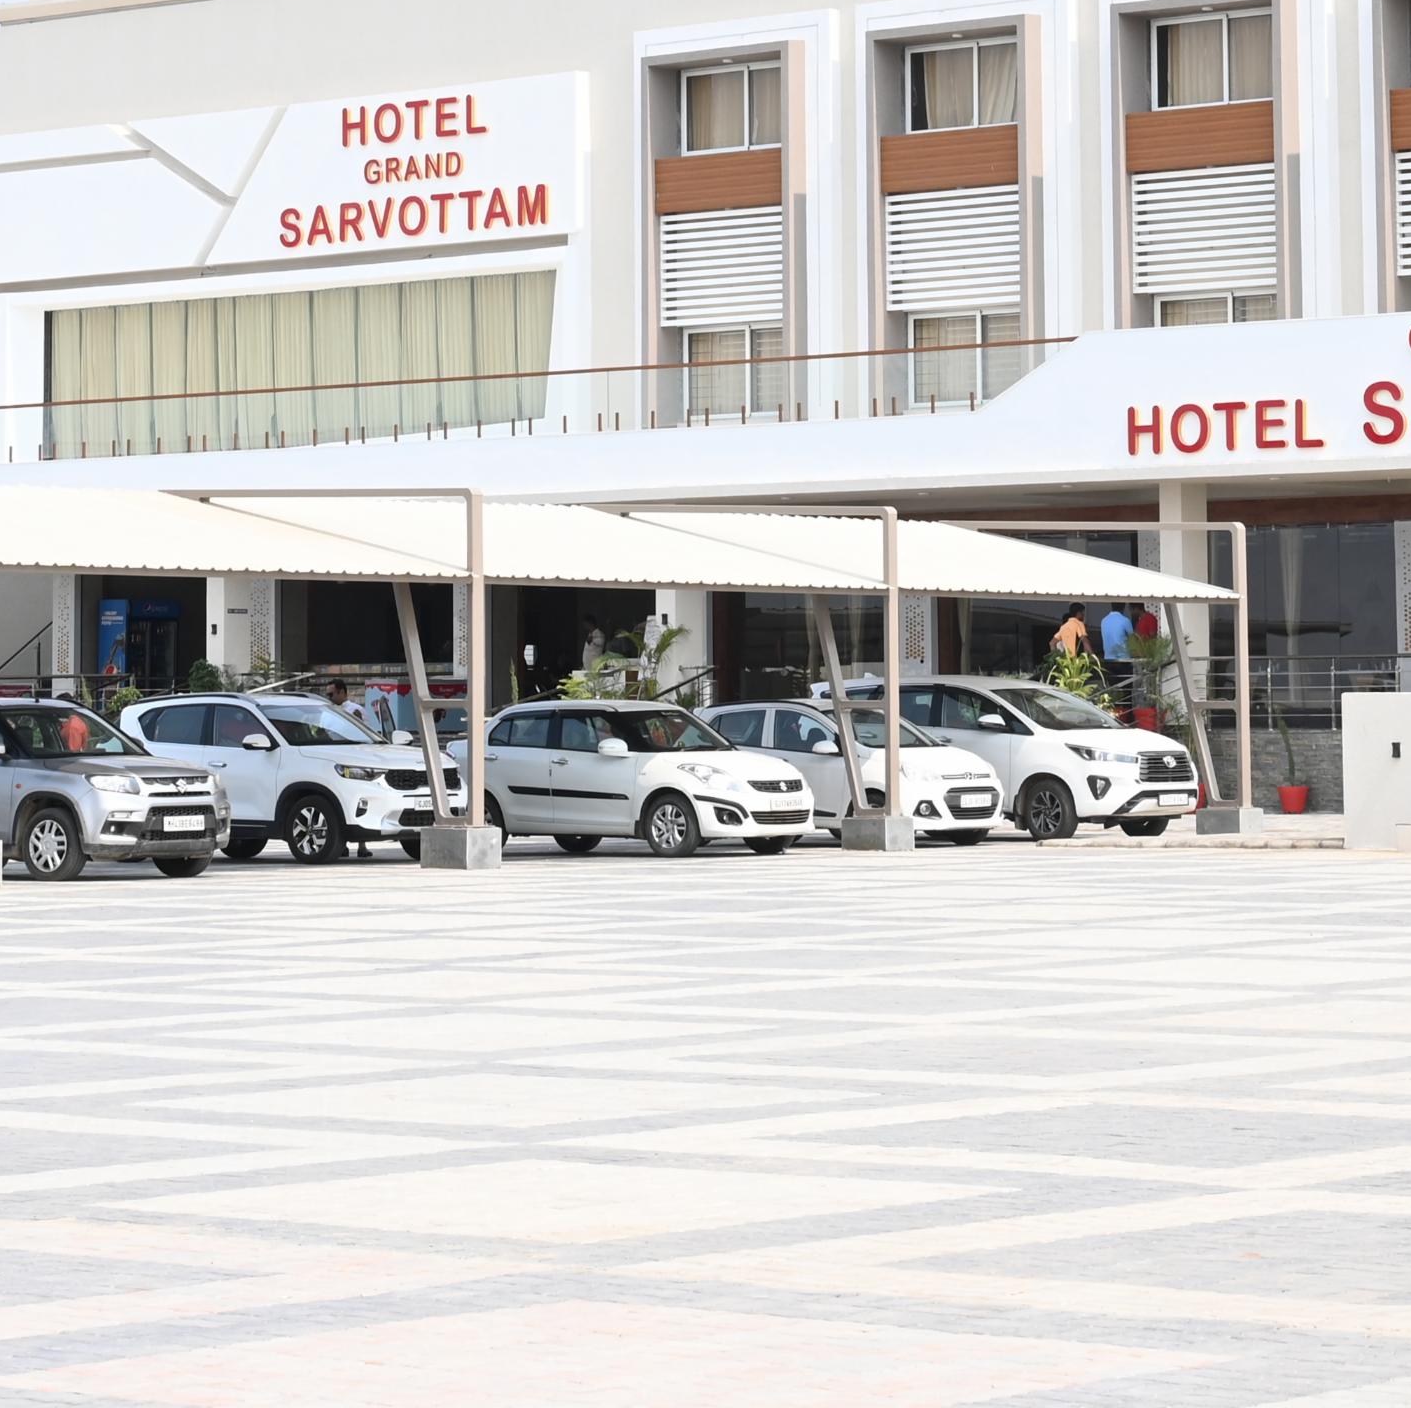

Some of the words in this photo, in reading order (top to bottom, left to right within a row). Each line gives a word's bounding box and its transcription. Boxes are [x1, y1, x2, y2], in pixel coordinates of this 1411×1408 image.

[341, 94, 487, 147] HOTEL
[363, 151, 463, 184] GRAND
[279, 182, 548, 249] SARVOTTAM
[1127, 399, 1325, 456] HOTEL
